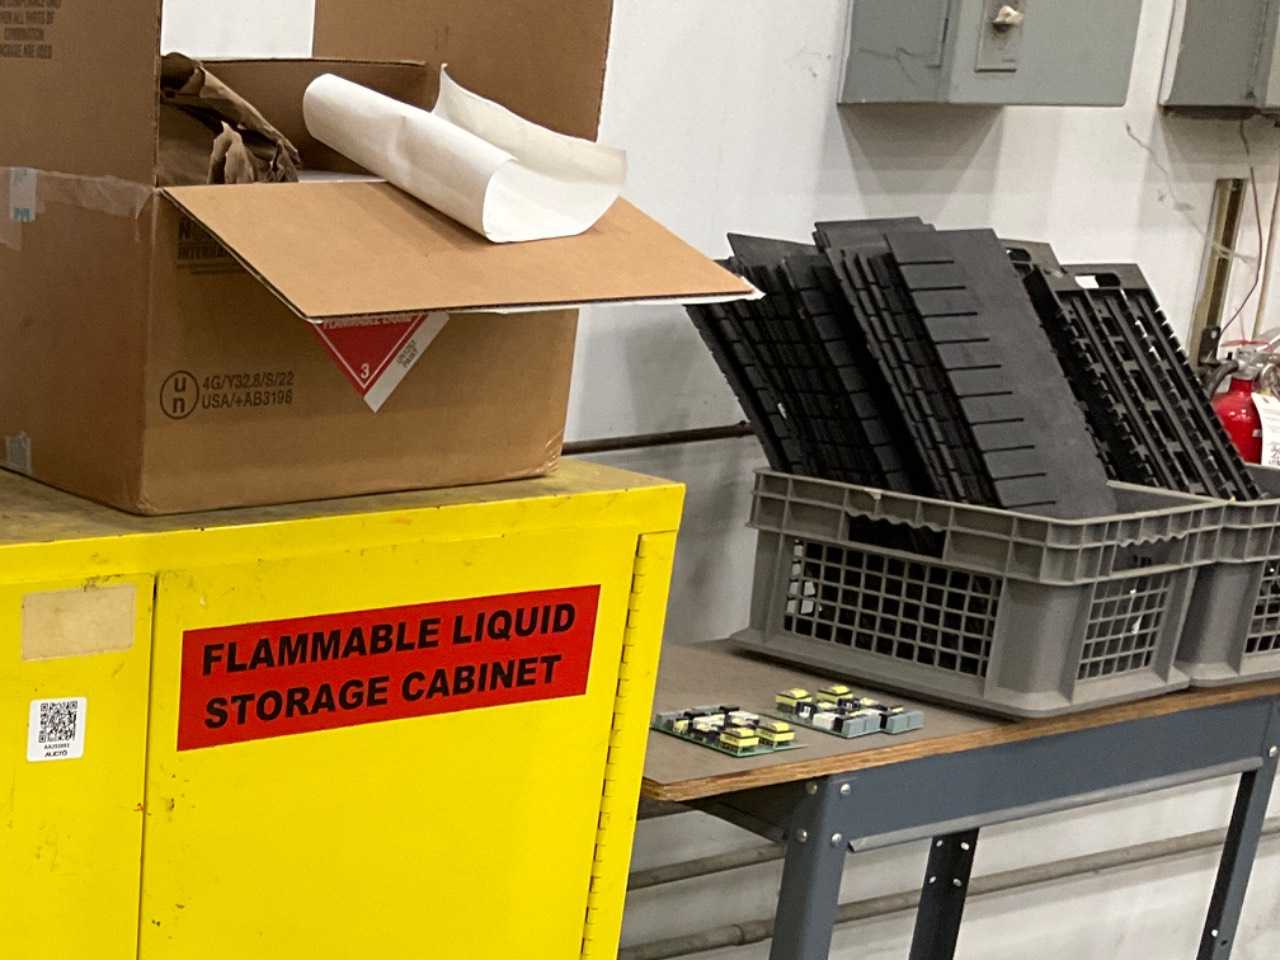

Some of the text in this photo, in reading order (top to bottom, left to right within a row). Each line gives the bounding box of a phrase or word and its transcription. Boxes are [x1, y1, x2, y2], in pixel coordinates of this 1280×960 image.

[360, 363, 370, 379] 3
[202, 603, 576, 676] FLAMMABLE LIQUID
[205, 654, 562, 729] STORAGE CABINET
